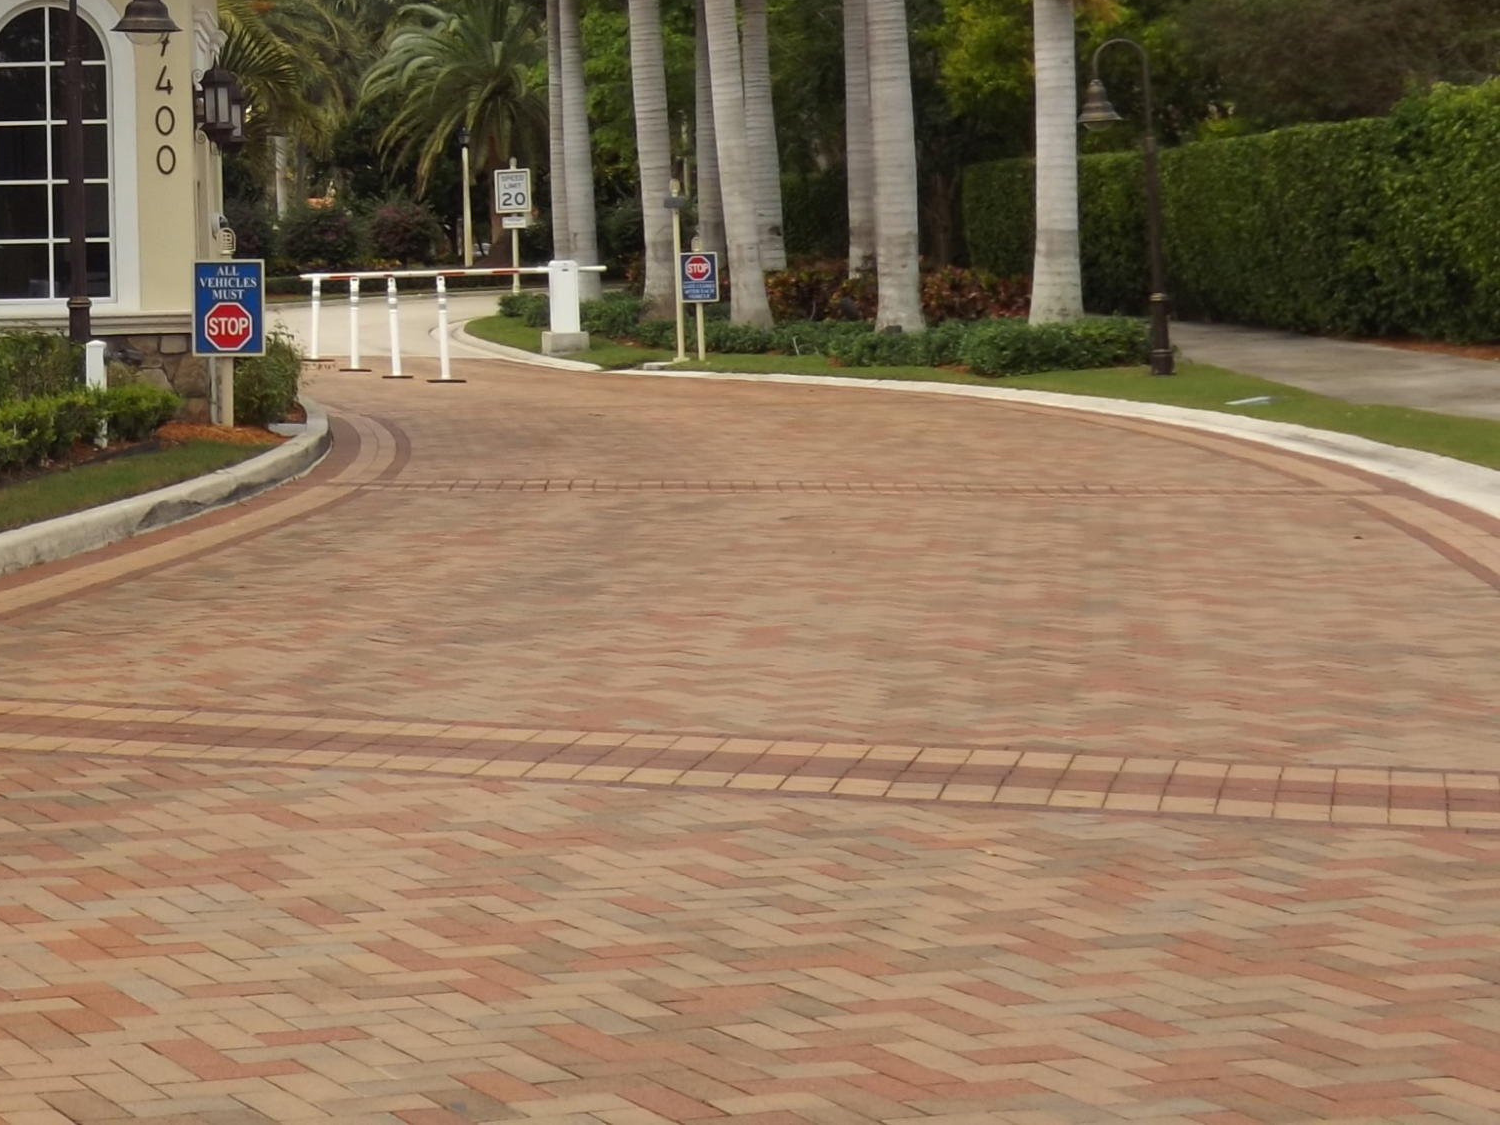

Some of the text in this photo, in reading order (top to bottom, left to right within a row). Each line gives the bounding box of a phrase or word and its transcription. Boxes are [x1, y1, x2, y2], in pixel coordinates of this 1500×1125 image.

[502, 192, 526, 207] 20
[216, 265, 240, 276] ALL
[687, 263, 709, 274] STOP
[199, 277, 258, 288] VEHICLES
[212, 289, 245, 300] MUST
[208, 317, 249, 336] STOP
